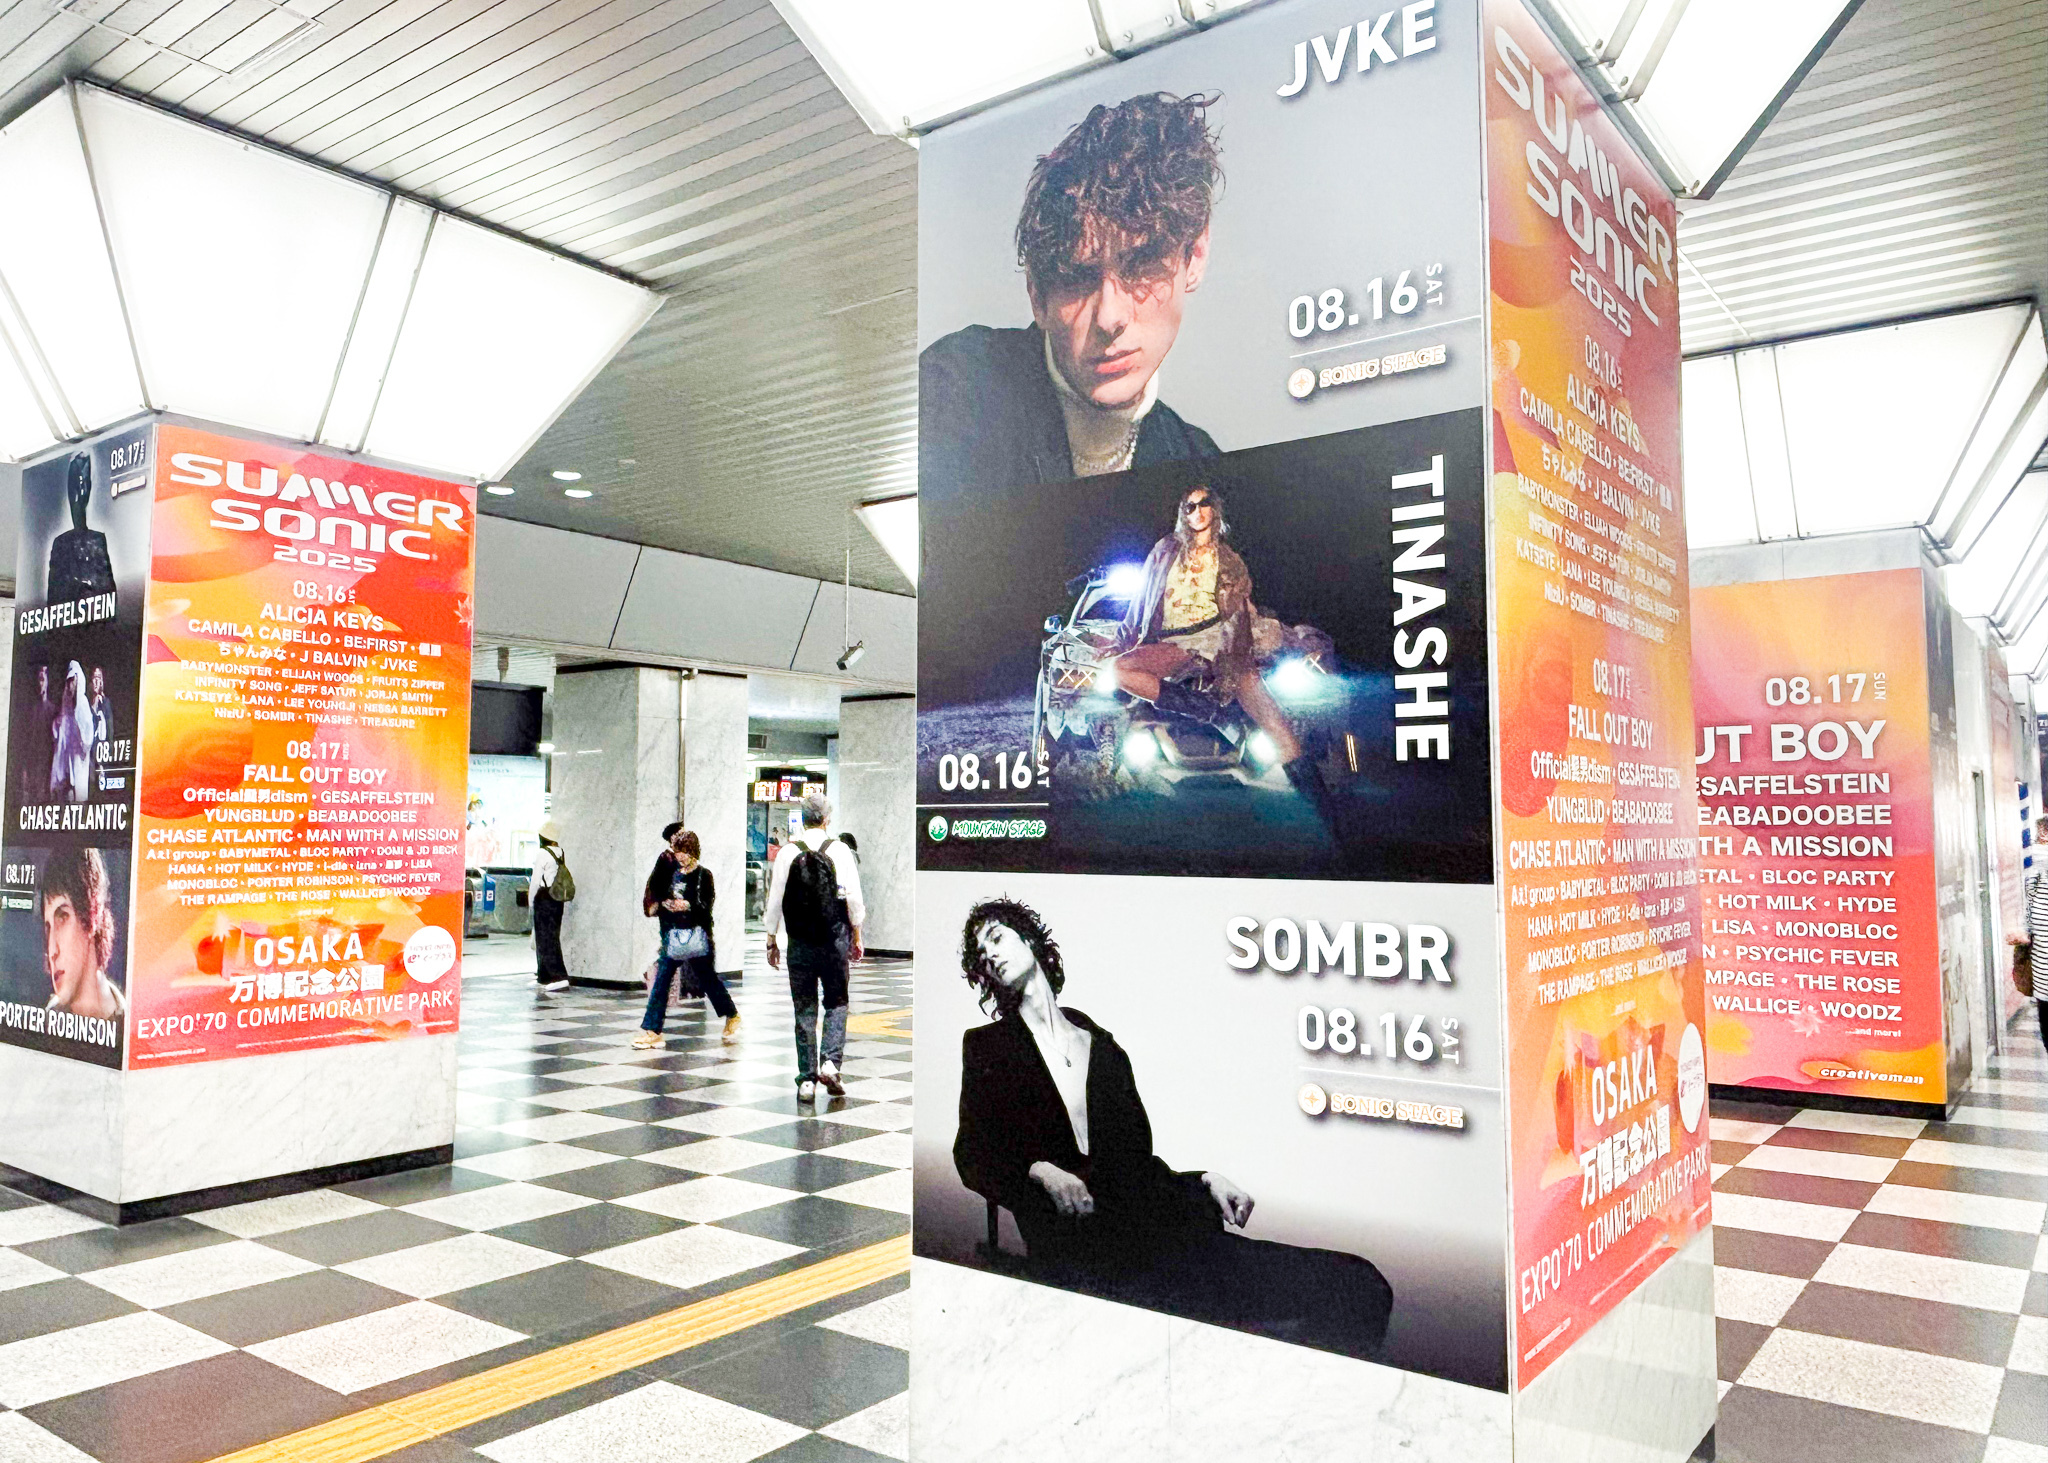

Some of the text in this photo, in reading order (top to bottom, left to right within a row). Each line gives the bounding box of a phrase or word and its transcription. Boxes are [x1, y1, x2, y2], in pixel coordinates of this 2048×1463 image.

[1275, 0, 1436, 97] JVKE
[1494, 25, 1673, 282] SUMMER
[1526, 140, 1658, 327] SONIC
[1288, 262, 1442, 338] 08.16 SAT
[1570, 254, 1632, 338] 2025
[1319, 344, 1446, 388] SONIC STAGE
[1585, 334, 1617, 388] 08.16
[1566, 373, 1608, 430] ALICIA
[1610, 405, 1640, 453] KEYS
[1520, 387, 1611, 469] CAMILA CABELLO
[111, 441, 140, 470] 08.17
[170, 453, 465, 532] SUMMER
[210, 499, 431, 560] SONIC
[273, 544, 377, 573] 2025
[293, 580, 346, 603] 08.16
[19, 592, 116, 635] GESAFFELSTEIN
[260, 603, 384, 632] ALICIA KEYS
[1391, 454, 1450, 762] TINASHE
[188, 619, 254, 638] CAMILA
[258, 627, 332, 645] CABELLO
[344, 635, 408, 653] BE:FIRST
[181, 660, 272, 677] BABYMONSTER
[299, 650, 309, 663] J
[313, 651, 368, 668] BALVIN
[379, 658, 418, 673] JVKE
[249, 680, 282, 692] SONG
[1593, 657, 1625, 699] 08.17
[1765, 672, 1887, 706] 08.17 SUN
[241, 694, 274, 707] LANA
[284, 697, 305, 708] LEE
[1568, 703, 1653, 751] FALL OUT BOY
[1770, 719, 1887, 762] BOY
[96, 740, 125, 762] 08.17
[286, 740, 340, 760] 08.17
[243, 764, 387, 785] FALL OUT BOY
[939, 750, 1050, 791] 08.16 SAT
[320, 790, 435, 805] GESAFFELSTEIN
[1546, 796, 1605, 824] YUNGBLUD
[20, 803, 127, 830] CHASE ATLANTIC
[204, 808, 417, 823] YUNGBLUD BEABADOOBEE
[952, 820, 1047, 838] MOUNTAIN STAGE
[146, 828, 459, 844] CHASE ATLANTIC MAN WITH A MISSION
[1741, 836, 1763, 857] A
[1770, 835, 1894, 857] MISSION
[172, 850, 210, 860] group
[219, 847, 291, 859] BABYMETAL
[299, 847, 330, 858] BLOC
[332, 846, 369, 857] PARTY
[416, 845, 430, 856] JD
[1509, 840, 1552, 870] CHASE
[1554, 839, 1606, 867] ATLANTIC
[168, 861, 314, 875] HANA HOT MILK HYDE
[1762, 870, 1895, 886] BLOC PARTY
[166, 878, 238, 890] MONOBLOC
[247, 877, 293, 888] PORTER
[1529, 886, 1556, 908] group
[180, 894, 205, 906] THE
[207, 892, 267, 905] RAMPAGE
[275, 891, 298, 902] THE
[1718, 894, 1897, 913] HOT MILK HYDE
[1711, 919, 1898, 940] LiSA MONOBLOC
[253, 932, 364, 967] OSAKA
[1225, 915, 1452, 983] SOMBR
[1735, 945, 1824, 964] PSYCHIC
[1830, 949, 1899, 967] FEVER
[1794, 973, 1837, 991] THE
[1842, 976, 1901, 994] ROSE
[237, 994, 403, 1028] COMMEMORATIVE
[408, 990, 453, 1012] PARK
[1712, 995, 1902, 1021] WALLICE WOODZ
[0, 1002, 117, 1048] PORTER ROBINSON
[1298, 1005, 1460, 1064] 08.16 SAT
[1591, 1044, 1658, 1127] OSAKA
[1820, 1067, 1924, 1085] creativeman
[1330, 1093, 1464, 1128] SONIC STAGE
[1587, 1168, 1684, 1263] COMMEMORATIVE
[1684, 1143, 1708, 1187] PARK
